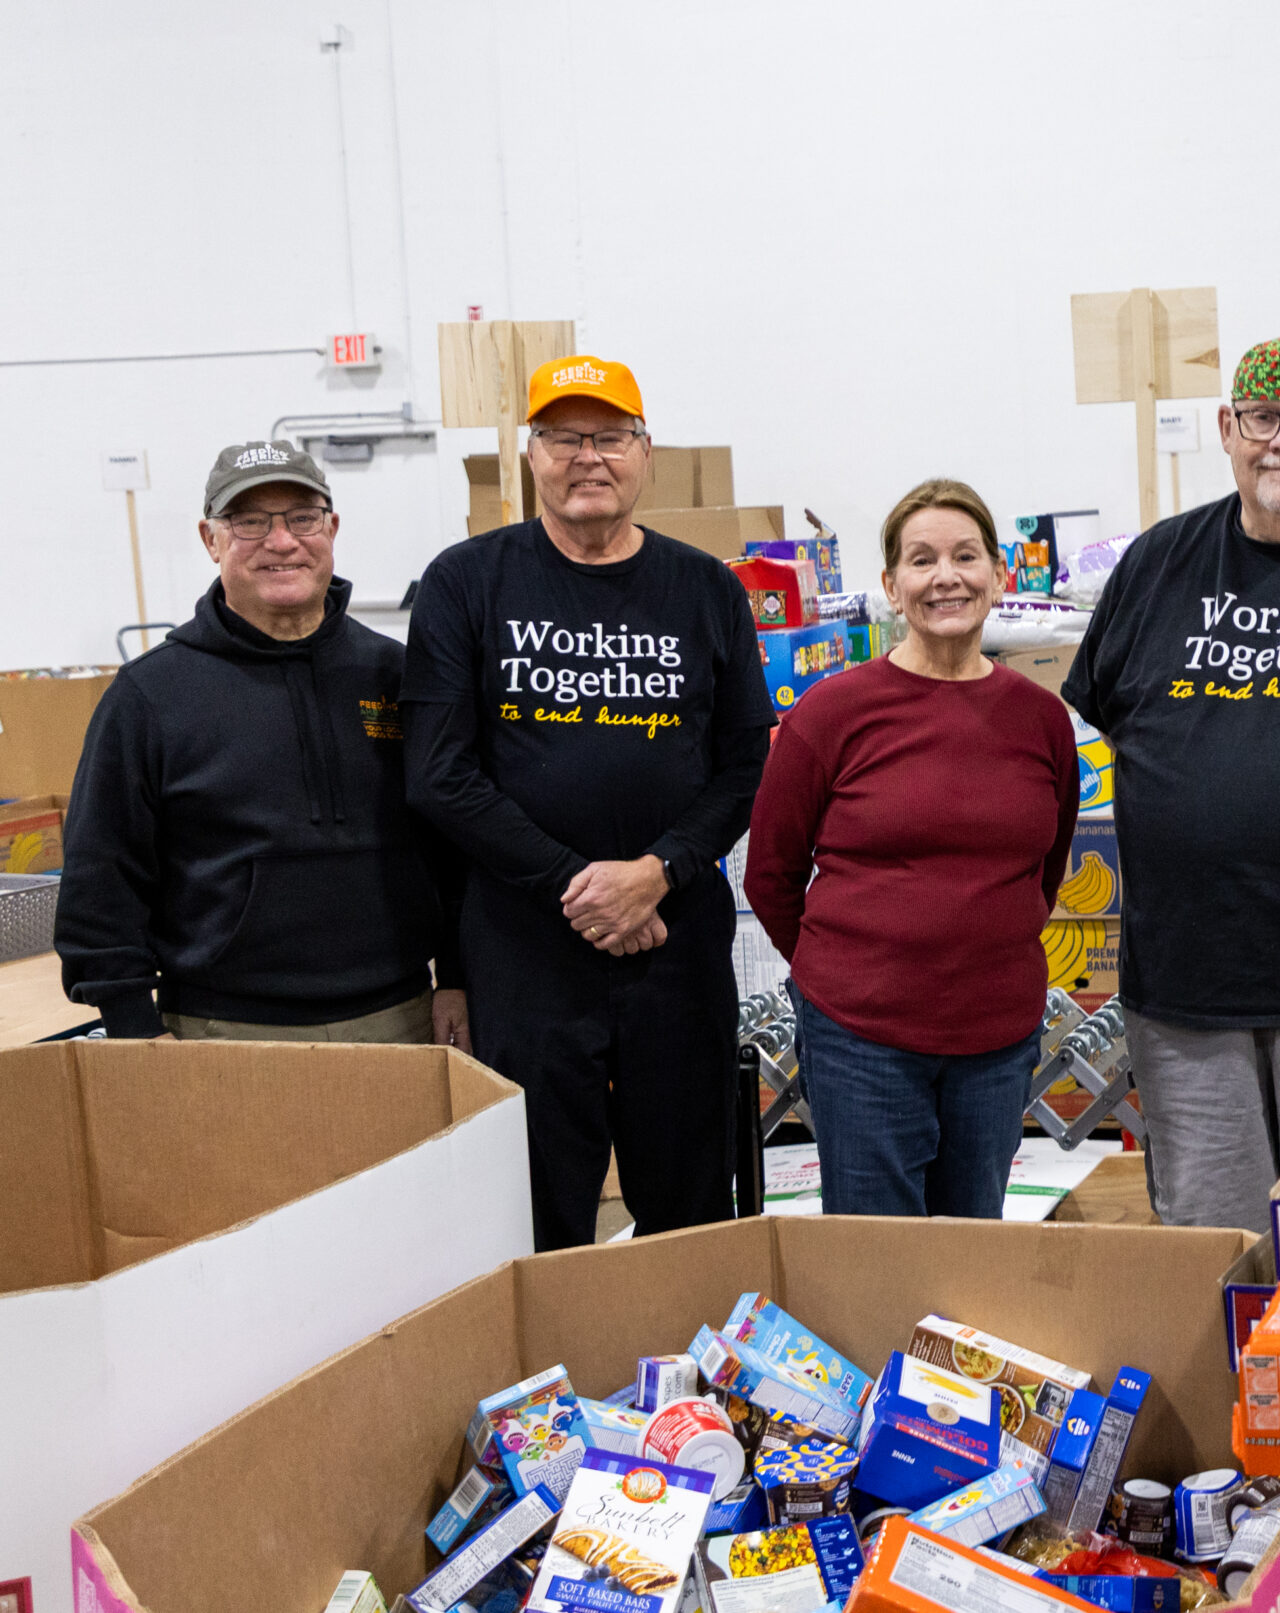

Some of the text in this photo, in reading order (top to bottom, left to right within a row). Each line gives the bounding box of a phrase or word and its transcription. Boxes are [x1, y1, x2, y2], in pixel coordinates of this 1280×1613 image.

[333, 334, 366, 364] EXIT
[507, 620, 682, 667] Working
[501, 657, 685, 703] Together
[1168, 679, 1195, 698] to
[1205, 681, 1253, 700] end
[780, 690, 790, 699] 42
[500, 703, 682, 739] to end hunger
[891, 1449, 916, 1465] PENNE
[577, 1494, 686, 1529] Sunbelt
[586, 1514, 676, 1541] BAKERY
[912, 1536, 955, 1561] Nutrition
[939, 1573, 961, 1589] 290
[555, 1592, 586, 1603] SWEET
[587, 1598, 614, 1610] FRUIT
[558, 1581, 651, 1610] SOFT BAKED BARS
